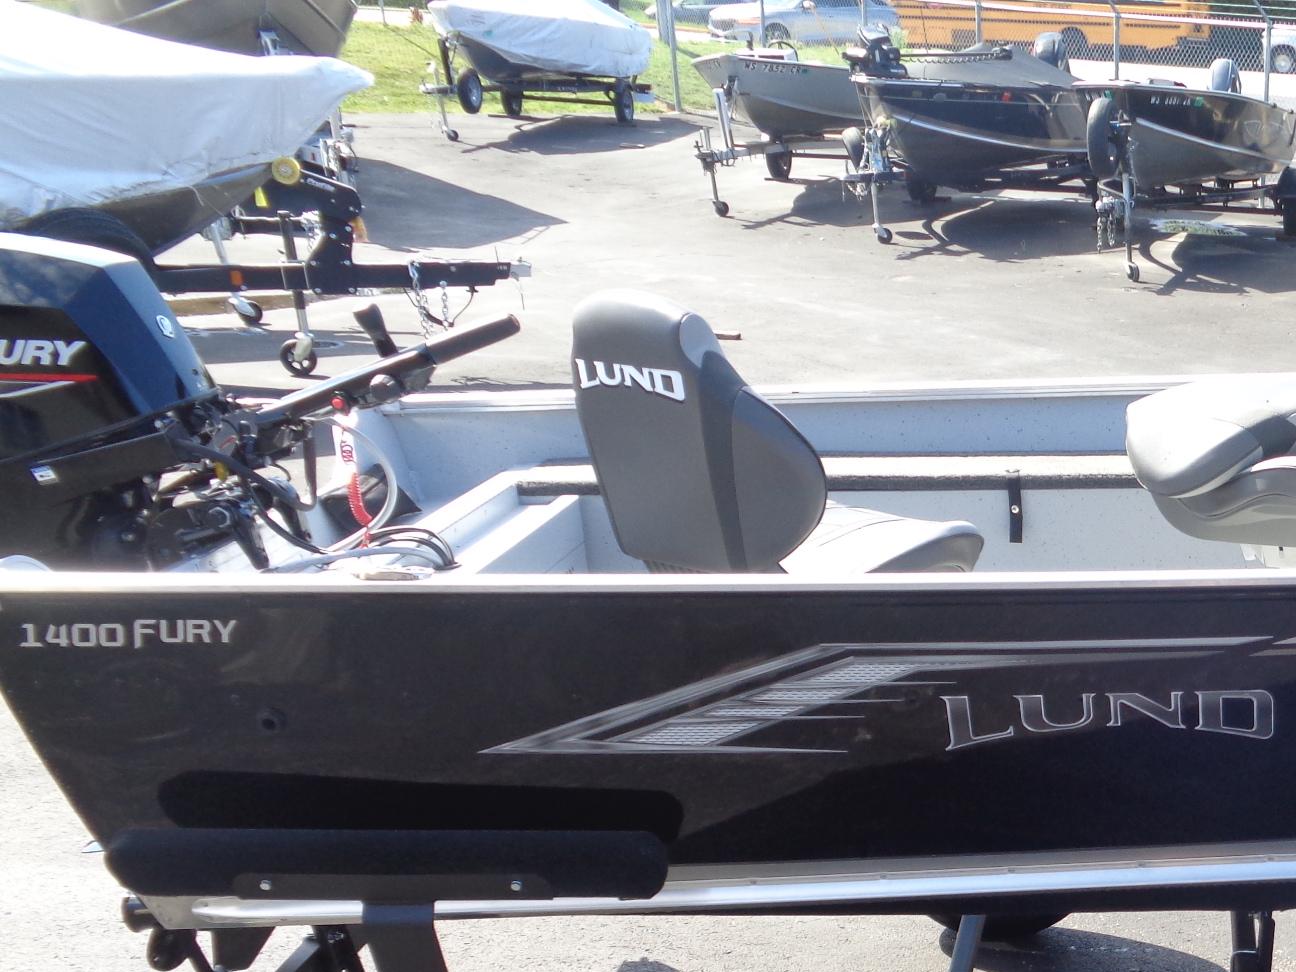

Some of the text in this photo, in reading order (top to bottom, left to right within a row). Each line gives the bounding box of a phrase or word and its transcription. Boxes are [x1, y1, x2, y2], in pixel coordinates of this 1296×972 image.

[575, 358, 685, 401] LUND
[19, 619, 237, 649] 1400 FURY
[939, 689, 1274, 751] LUND
